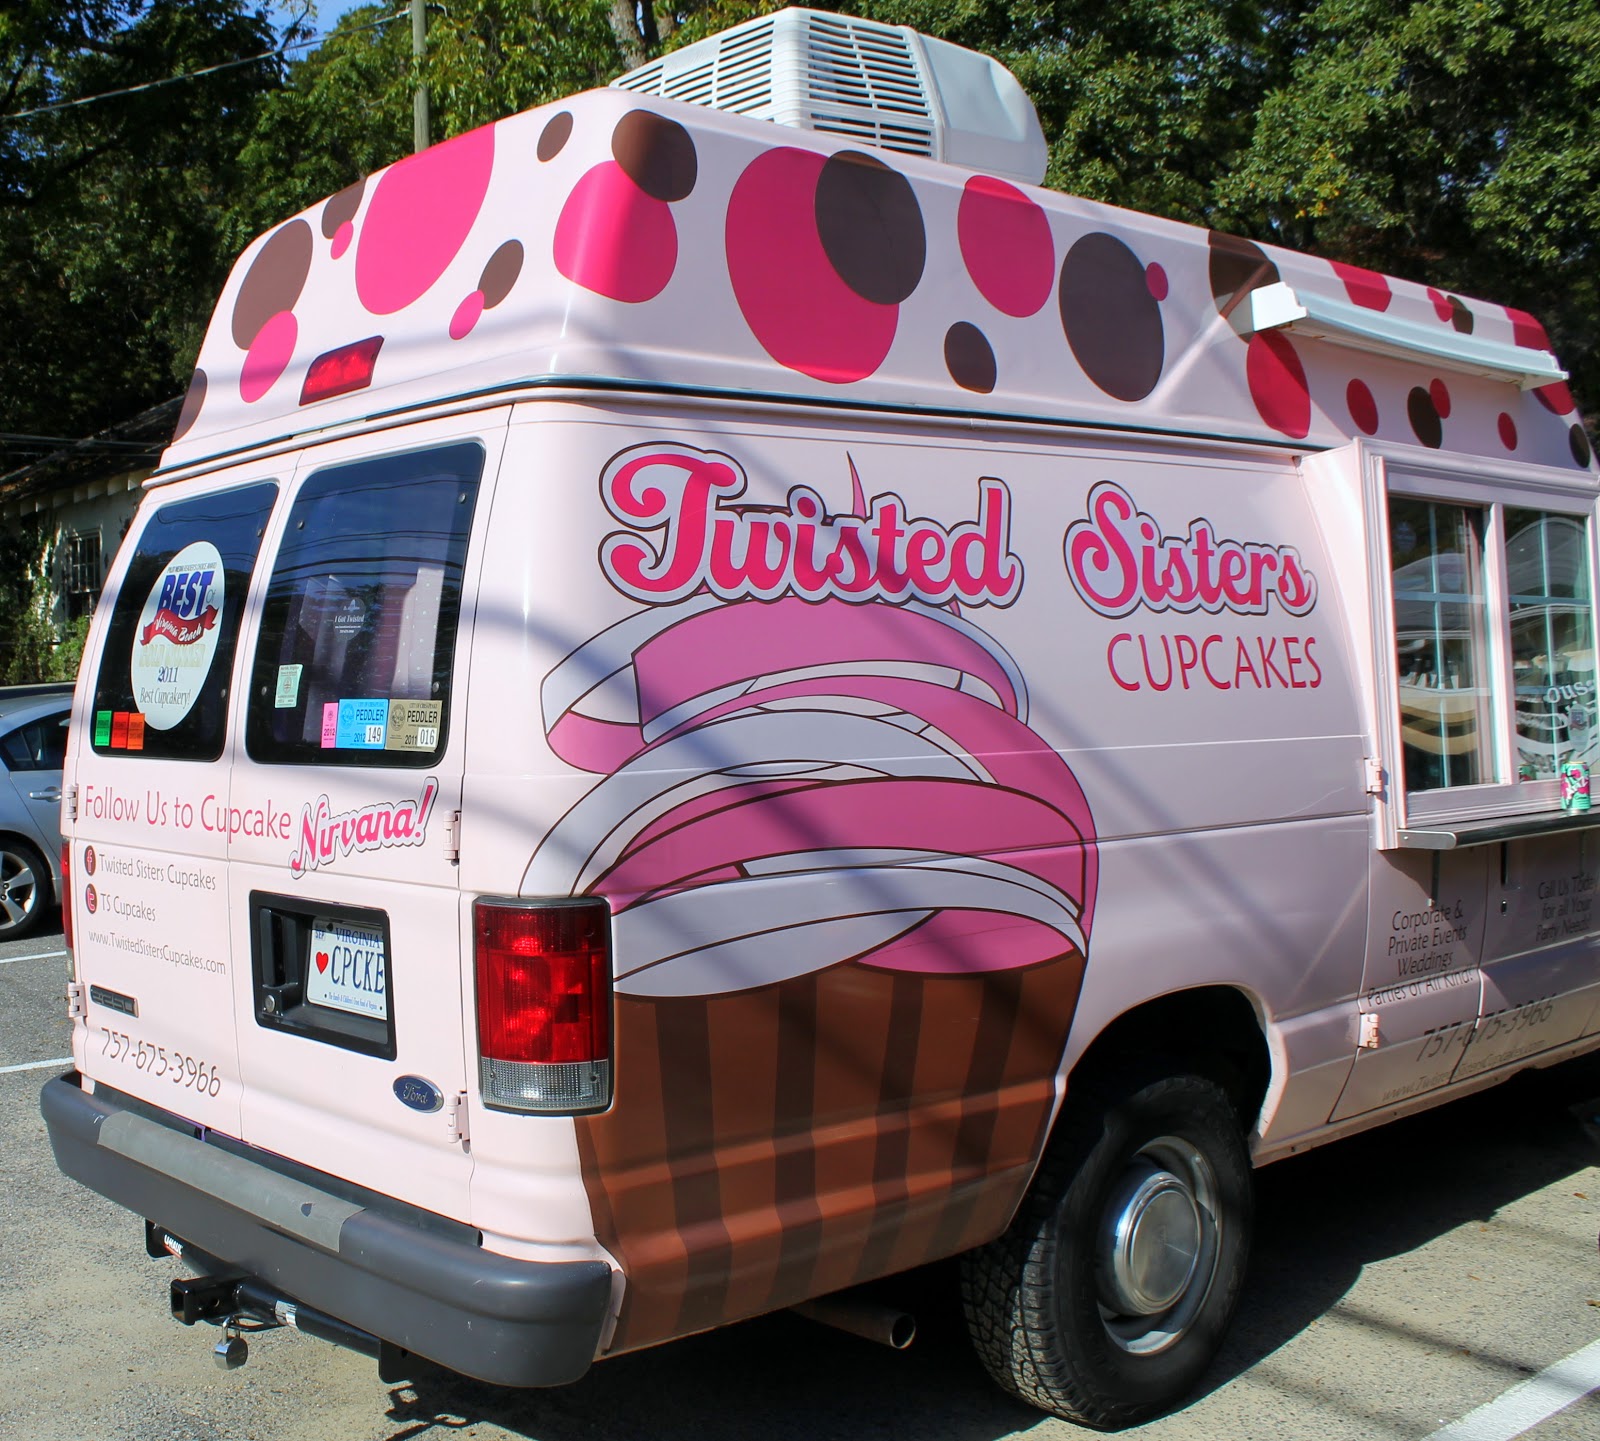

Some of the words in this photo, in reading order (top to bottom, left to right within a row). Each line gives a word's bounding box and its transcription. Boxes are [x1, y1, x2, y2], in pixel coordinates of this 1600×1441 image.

[603, 444, 1021, 604] Twisted
[1066, 483, 1315, 616] Sisters
[157, 570, 215, 617] BEST
[154, 611, 179, 637] Virginia
[178, 623, 202, 642] Beach
[158, 666, 179, 683] 2011
[1107, 632, 1322, 691] CUPCAKES
[140, 687, 154, 703] Best
[356, 709, 384, 721] PEDDLER
[407, 710, 438, 723] PEDDLER
[323, 728, 336, 737] 2012
[353, 732, 366, 743] 2012
[367, 726, 382, 743] 149
[404, 734, 418, 745] 2011
[420, 728, 435, 745] 016
[85, 785, 140, 822] Follow
[147, 790, 168, 826] Us
[174, 797, 194, 829] to
[200, 794, 292, 844] Cupcake
[290, 779, 437, 875] Nirvana!
[99, 853, 134, 876] Twisted
[136, 859, 165, 882] Sisters
[167, 864, 216, 891] Cupcakes
[100, 893, 111, 912] TS
[113, 896, 156, 922] Cupcakes
[1392, 905, 1451, 933] Corporate
[1454, 899, 1464, 920] &
[336, 927, 381, 949] VIRGINIA
[1388, 933, 1429, 956] Private
[1432, 926, 1468, 947] Events
[88, 930, 227, 975] www.TwistedSistersCupcakes.com
[1397, 950, 1454, 977] Weddings
[1367, 984, 1407, 1007] Parties
[1425, 976, 1442, 993] All
[100, 1027, 222, 1098] 757-675-3966
[403, 1082, 429, 1104] Ford
